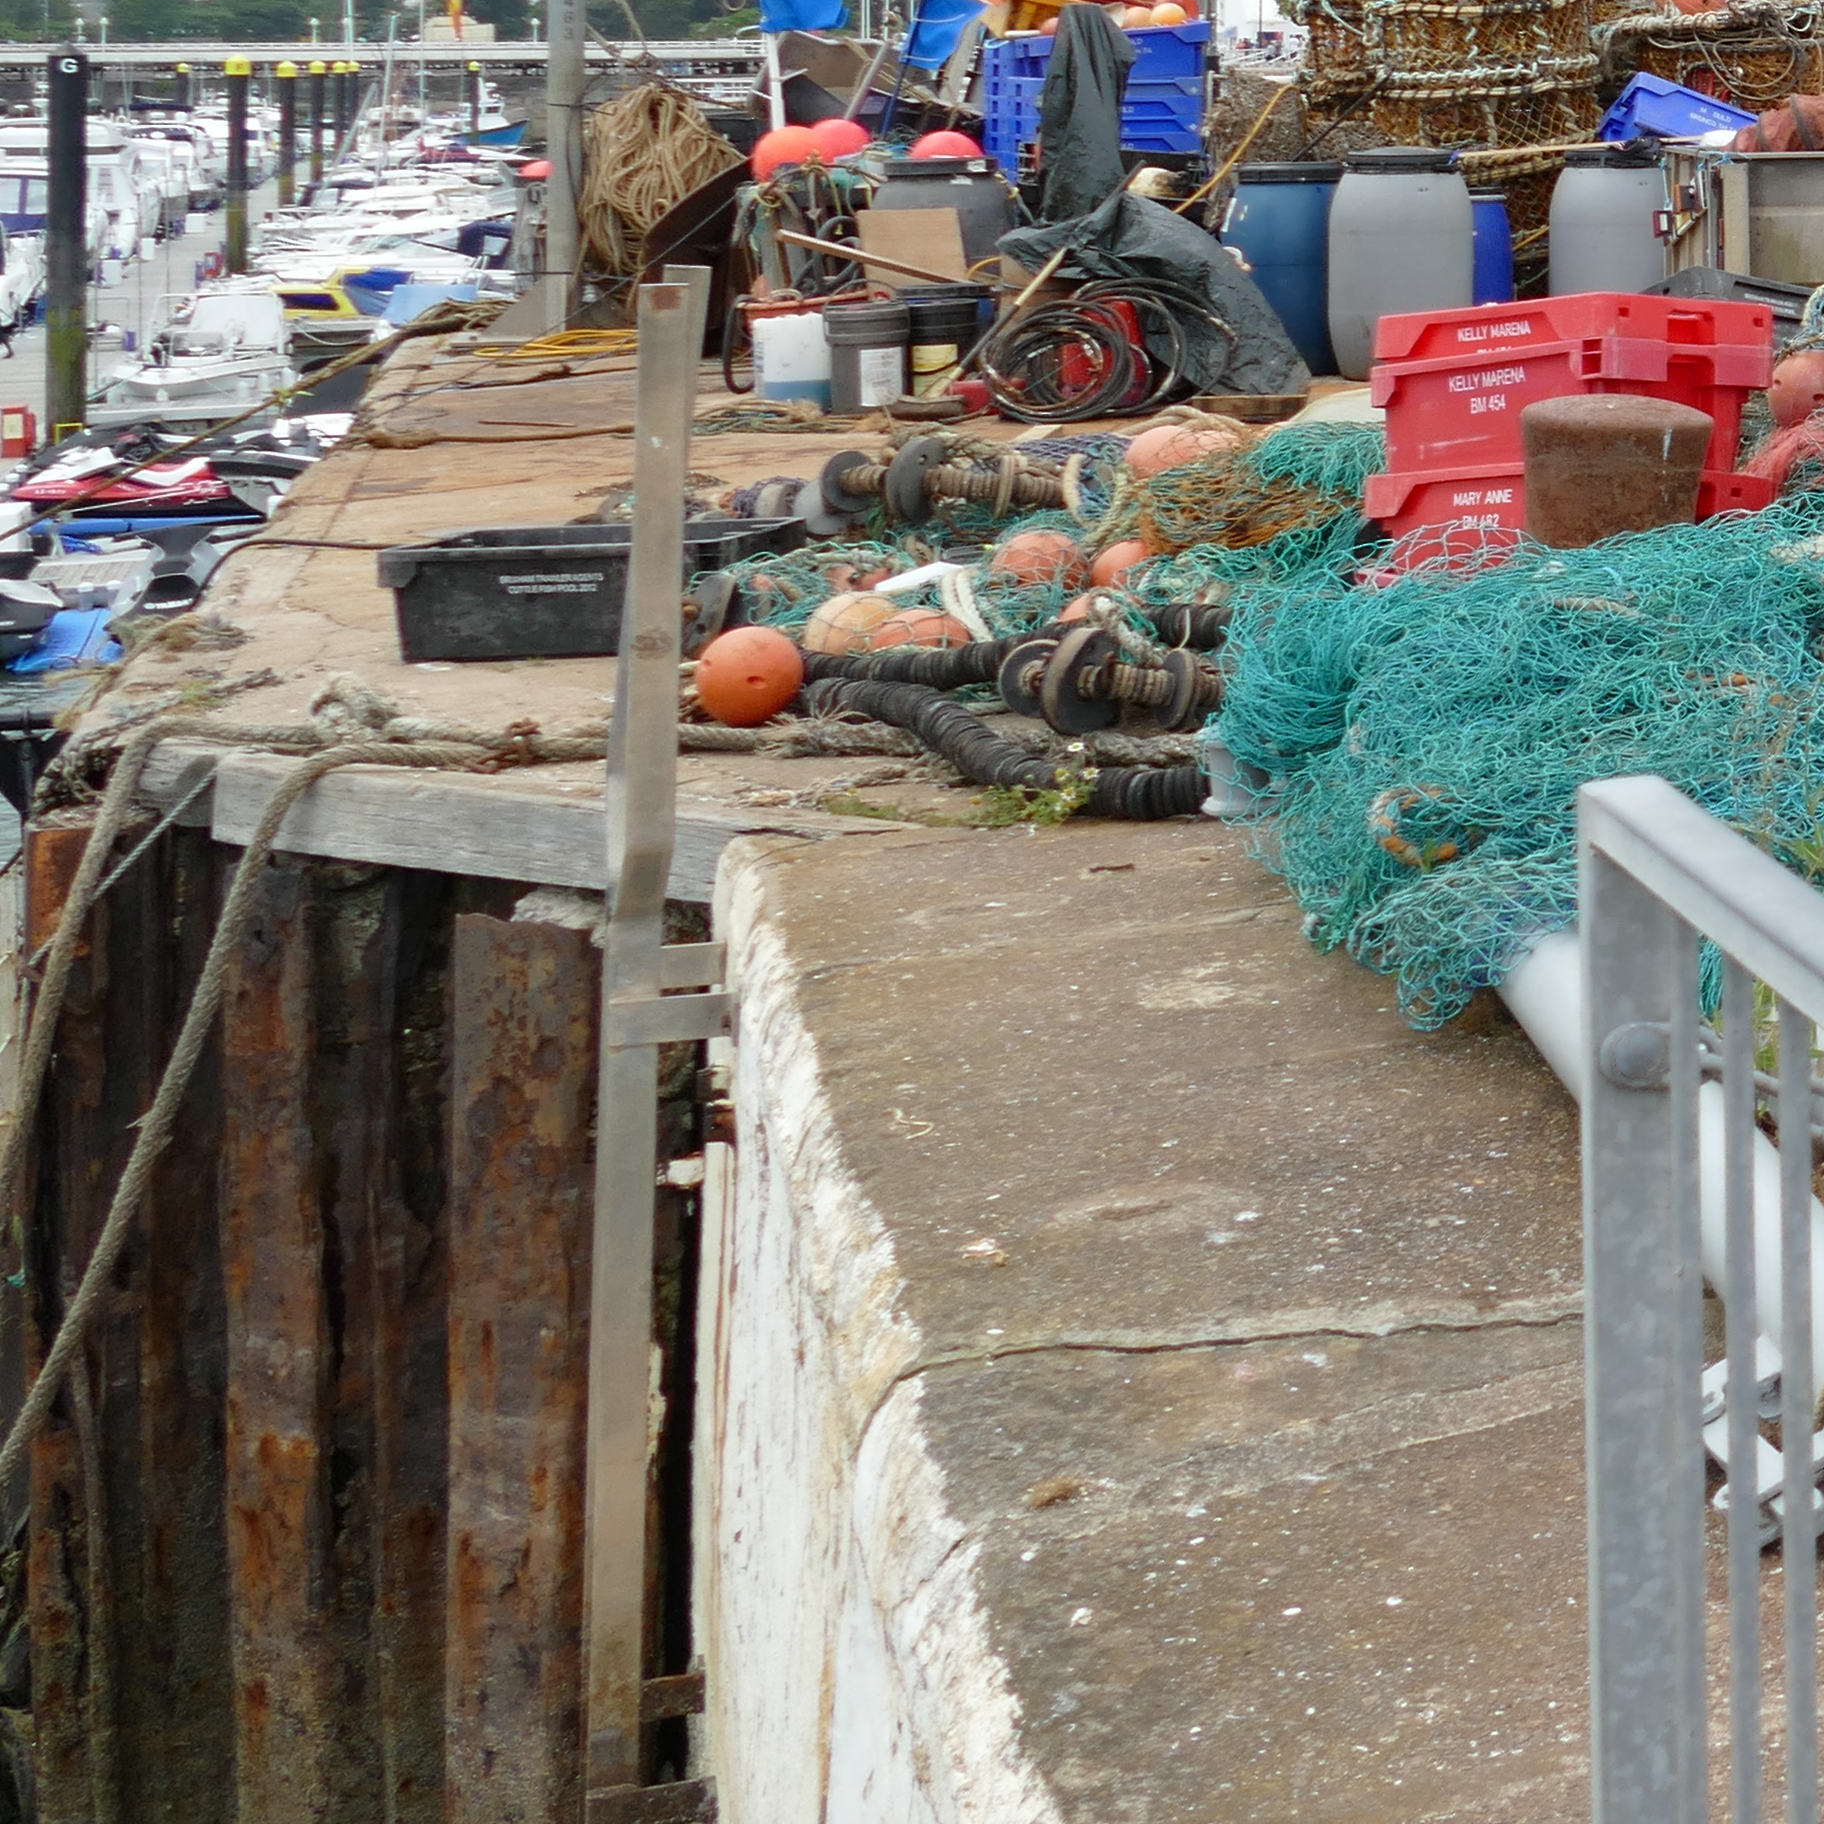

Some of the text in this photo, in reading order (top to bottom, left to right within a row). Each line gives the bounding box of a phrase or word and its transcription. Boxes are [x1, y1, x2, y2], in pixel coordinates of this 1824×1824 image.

[60, 58, 78, 74] G
[1457, 320, 1531, 342] KELLY MARENA
[1449, 366, 1526, 393] KELLY MARENA
[1470, 393, 1506, 414] BM 454
[1453, 488, 1513, 507] MARY ANNE
[539, 584, 557, 593] FISH
[557, 584, 578, 592] POOL
